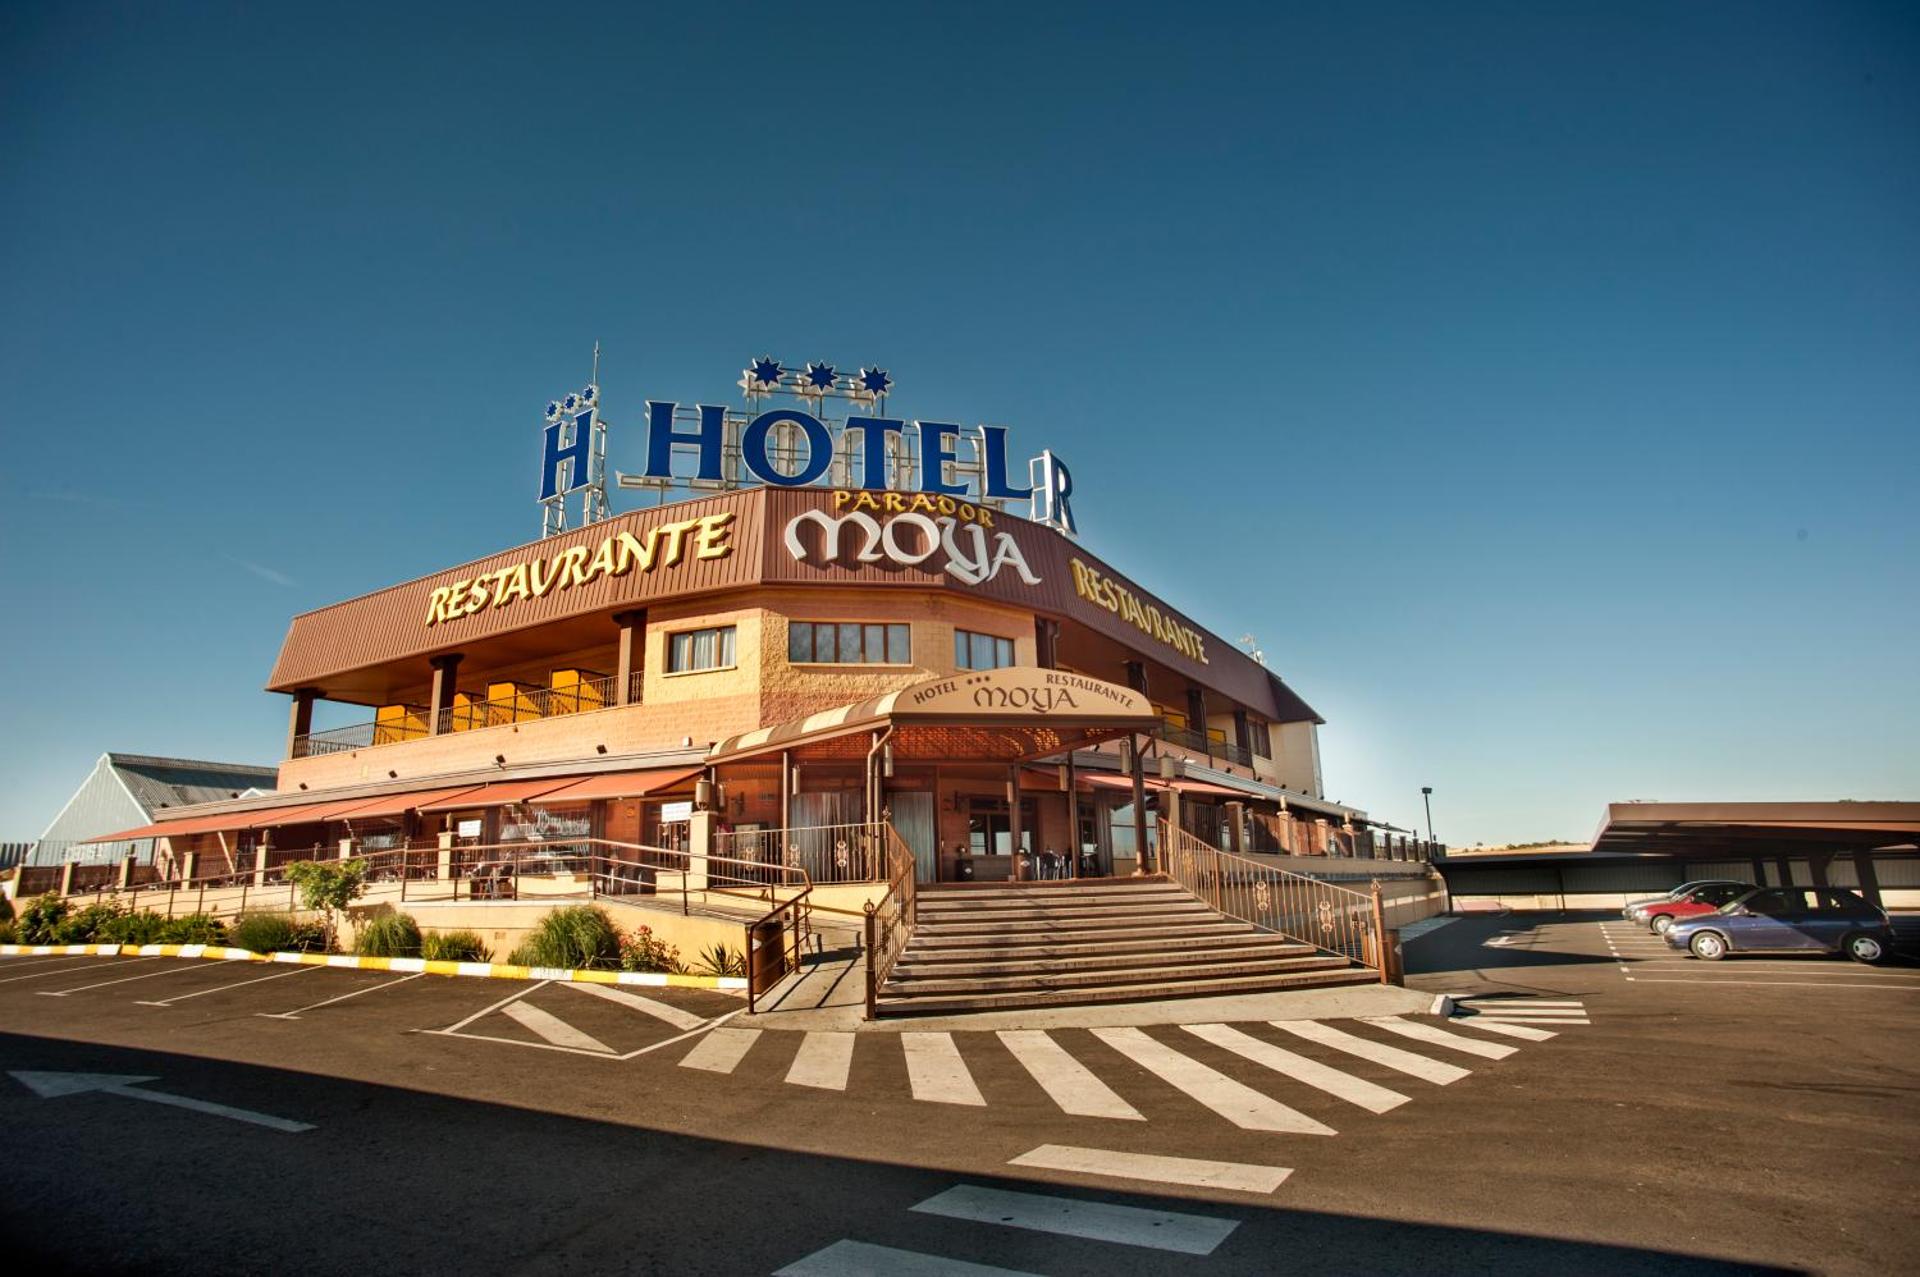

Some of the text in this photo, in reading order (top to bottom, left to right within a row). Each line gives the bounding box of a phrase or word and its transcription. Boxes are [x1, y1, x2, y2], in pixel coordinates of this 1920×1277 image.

[538, 407, 597, 503] H
[645, 400, 1034, 500] HOTEL
[833, 490, 995, 528] PARADOR
[1043, 449, 1078, 537] R
[913, 681, 958, 705] HOTEL
[1046, 673, 1134, 709] RESTAURANTE
